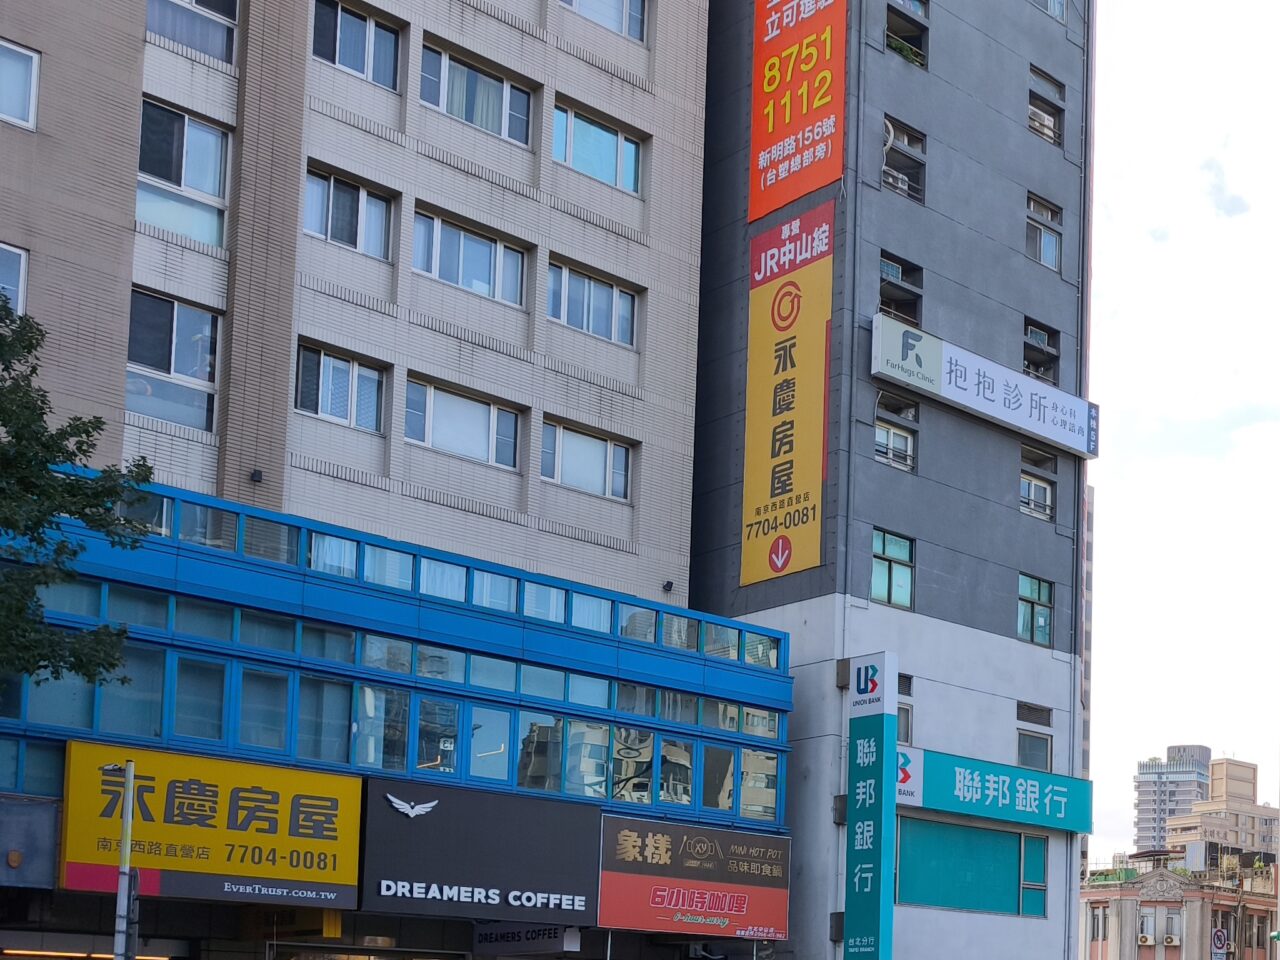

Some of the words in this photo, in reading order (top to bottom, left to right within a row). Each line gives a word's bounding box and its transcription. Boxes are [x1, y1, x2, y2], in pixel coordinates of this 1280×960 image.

[763, 25, 832, 93] 8751
[763, 69, 832, 134] 1112
[758, 114, 836, 170] 新明路156號
[760, 139, 832, 192] (台塑總部旁)
[754, 223, 830, 281] JR中山綻
[886, 359, 915, 378] FarHugs
[916, 371, 936, 386] Clinic
[946, 356, 1049, 425] 抱抱診所
[770, 335, 797, 499] 永慶房屋
[1051, 402, 1077, 420] 身心科
[745, 503, 818, 541] 7704-0081
[868, 696, 881, 705] BANK
[99, 768, 340, 841] 永慶房屋
[898, 788, 916, 798] BANK
[953, 766, 1068, 819] 聯邦銀行
[854, 736, 877, 893] 聯邦銀行
[225, 843, 337, 872] 7704-0081
[616, 829, 672, 865] 象樣
[749, 846, 766, 857] HOT
[766, 848, 783, 860] POT
[727, 860, 783, 878] 品味即食鍋
[380, 879, 501, 905] DREAMERS
[508, 890, 586, 911] COFFEE
[650, 886, 748, 915] 6小時咖哩
[478, 930, 522, 944] DREAMERS
[525, 927, 559, 941] COFFEE
[848, 936, 875, 946] 台北分行
